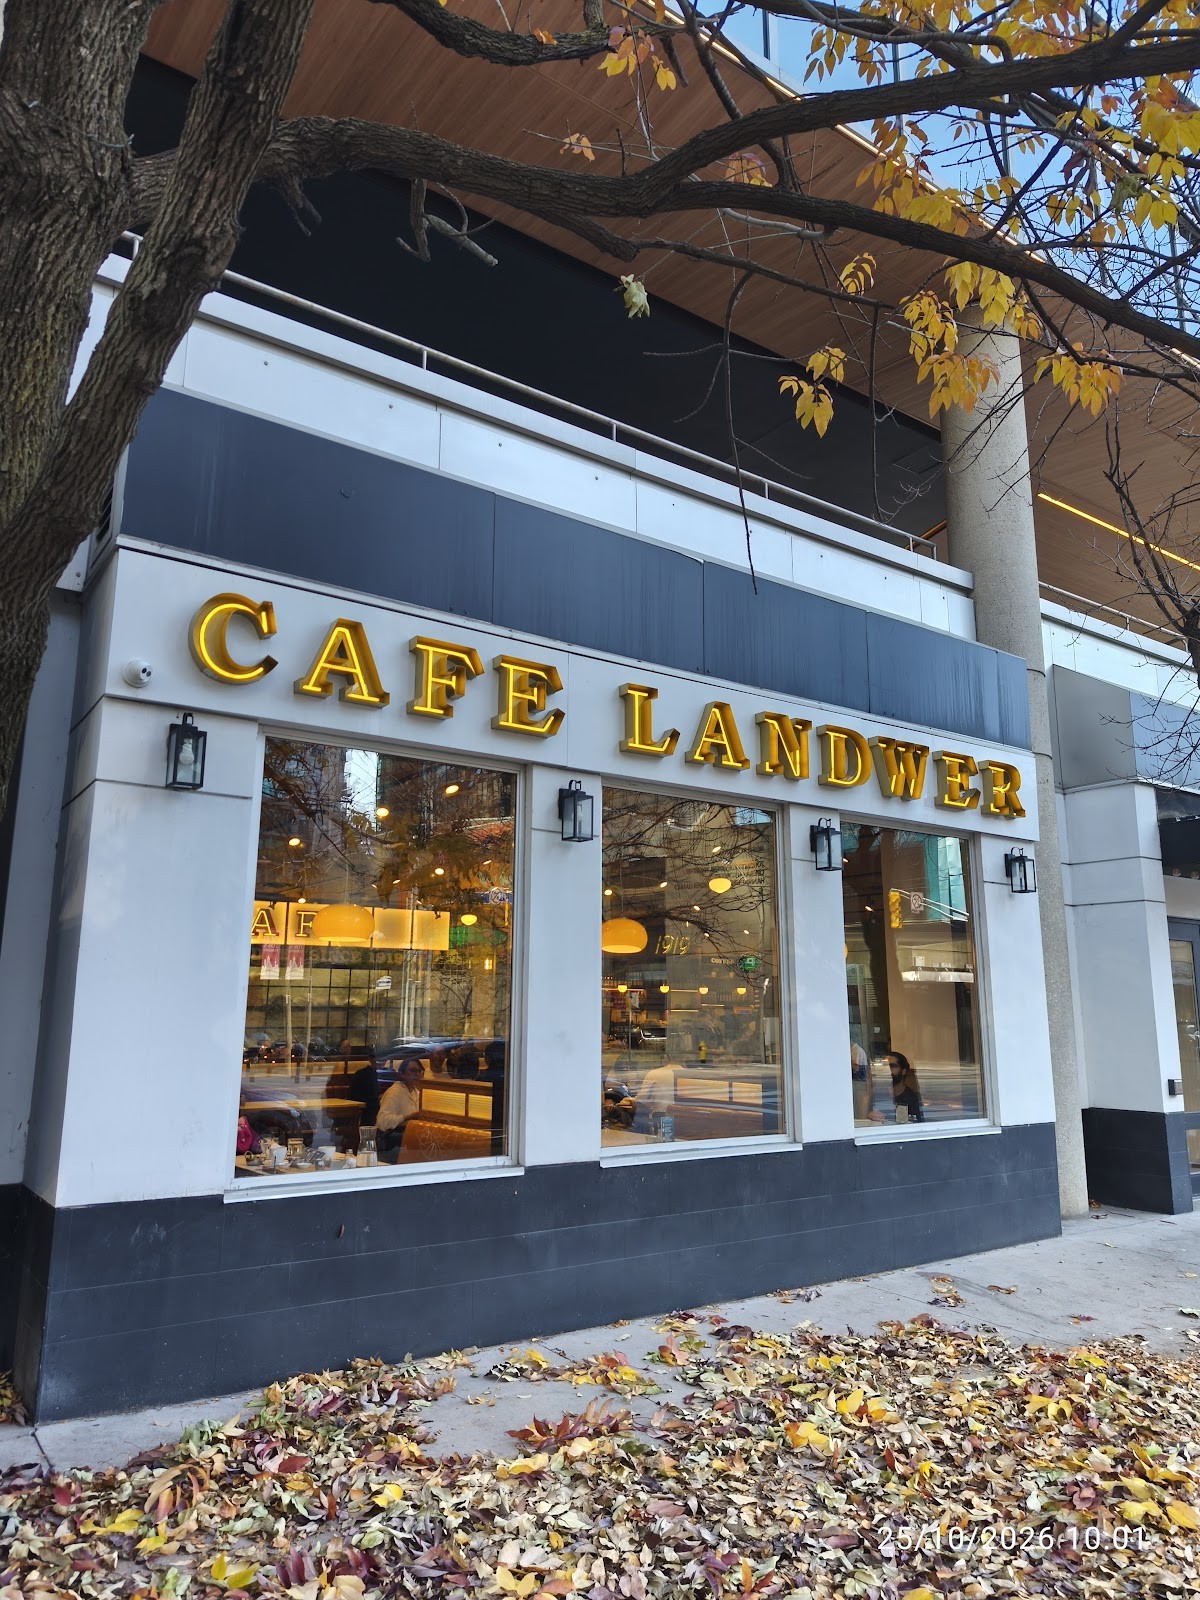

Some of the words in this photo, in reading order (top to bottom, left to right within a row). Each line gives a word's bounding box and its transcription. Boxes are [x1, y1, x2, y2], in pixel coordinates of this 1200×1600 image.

[188, 592, 565, 738] CAFE
[619, 683, 1026, 819] LANDWER
[655, 934, 690, 954] 1919
